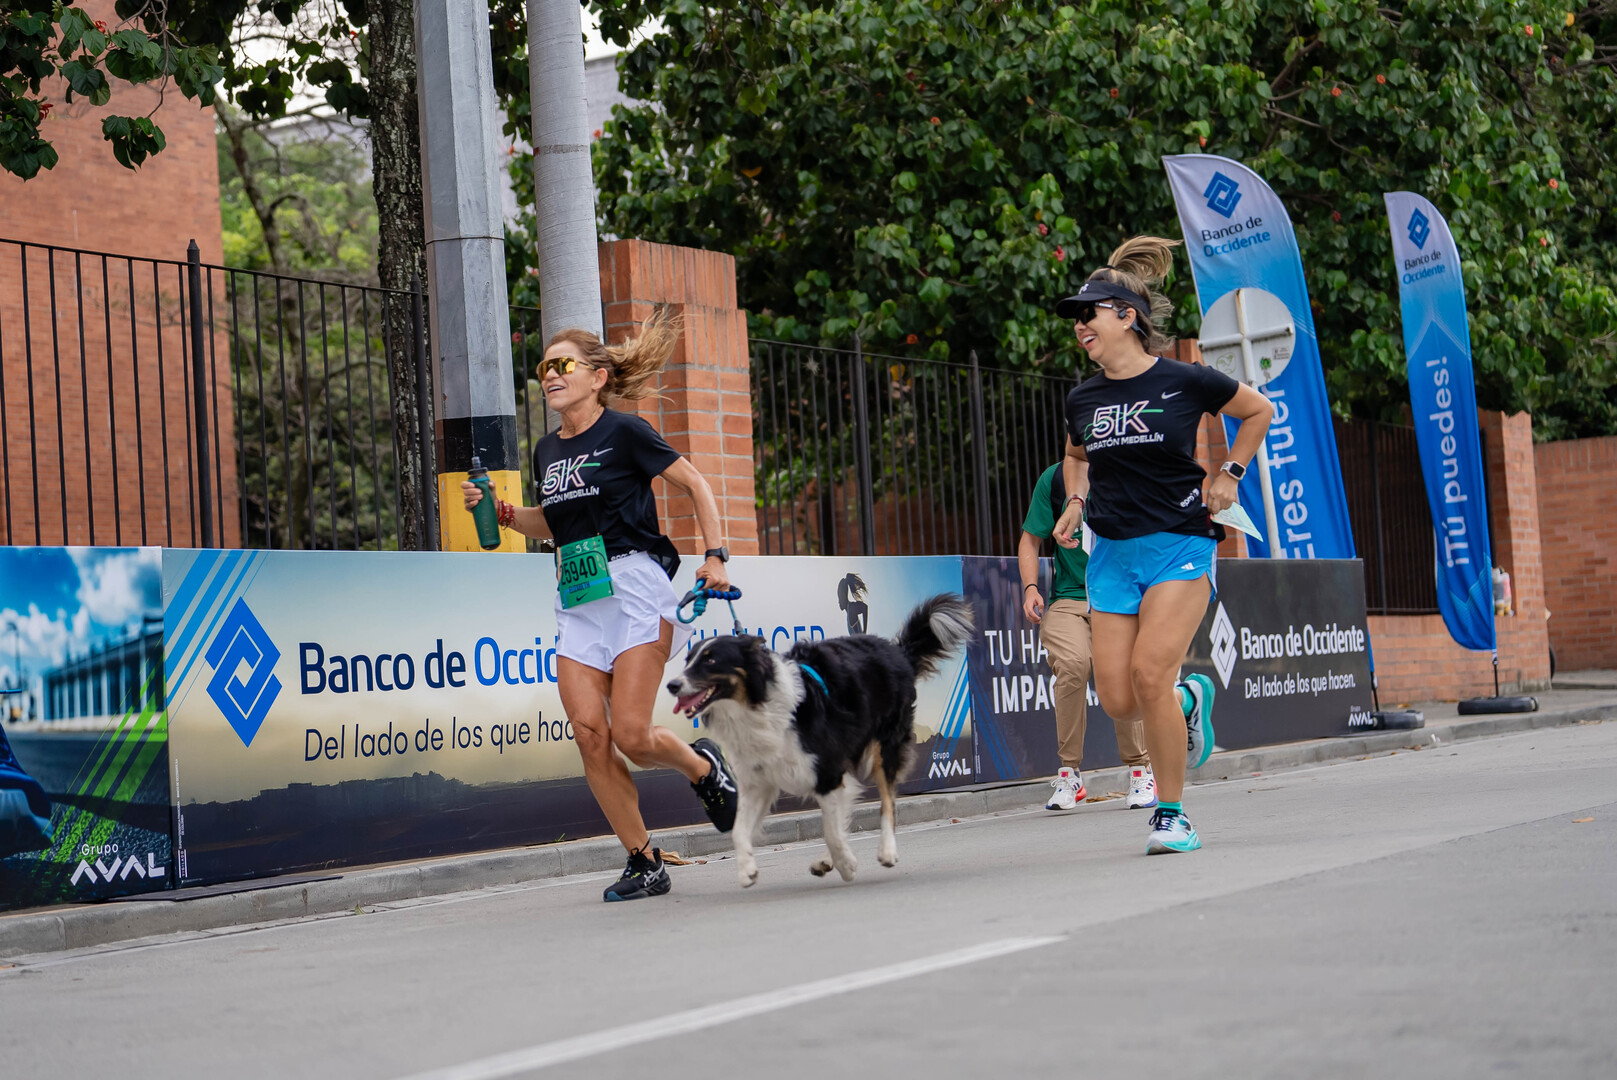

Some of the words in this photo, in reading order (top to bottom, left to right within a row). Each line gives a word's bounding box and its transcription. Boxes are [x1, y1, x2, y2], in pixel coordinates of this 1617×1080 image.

[1201, 223, 1243, 242] Banco
[1245, 216, 1263, 229] de
[1203, 231, 1271, 257] Occidente
[1404, 254, 1430, 270] Banco
[1430, 249, 1442, 261] de
[1402, 263, 1446, 285] Occidente
[1092, 400, 1150, 439] 5K
[1261, 386, 1298, 470] fuer
[1426, 356, 1468, 503] puedes!
[1086, 436, 1120, 453] MARATÓN
[1121, 432, 1165, 445] MEDELLÍN
[541, 454, 590, 496] 5K
[564, 485, 600, 501] MEDELLÍN
[984, 630, 1013, 666] TU
[1020, 629, 1050, 664] HA
[1240, 626, 1284, 660] Banco
[1285, 624, 1303, 657] de
[1303, 622, 1365, 656] Occidente
[298, 642, 416, 695] Banco
[424, 638, 467, 689] de
[474, 635, 559, 686] Occid
[1244, 675, 1261, 699] Del
[1262, 674, 1283, 697] lado
[1283, 673, 1296, 695] de
[1296, 671, 1310, 693] los
[1311, 676, 1328, 697] que
[1328, 669, 1356, 690] hacen.
[1348, 711, 1373, 727] AVAL
[304, 724, 346, 762] Del
[354, 721, 408, 758] lado
[414, 718, 444, 752] de
[451, 716, 483, 749] los
[490, 721, 531, 755] que
[537, 710, 576, 743] hac
[928, 757, 972, 780] AVAL
[932, 751, 950, 760] Grupo
[81, 843, 119, 856] Grupo
[70, 852, 165, 887] AVAL
